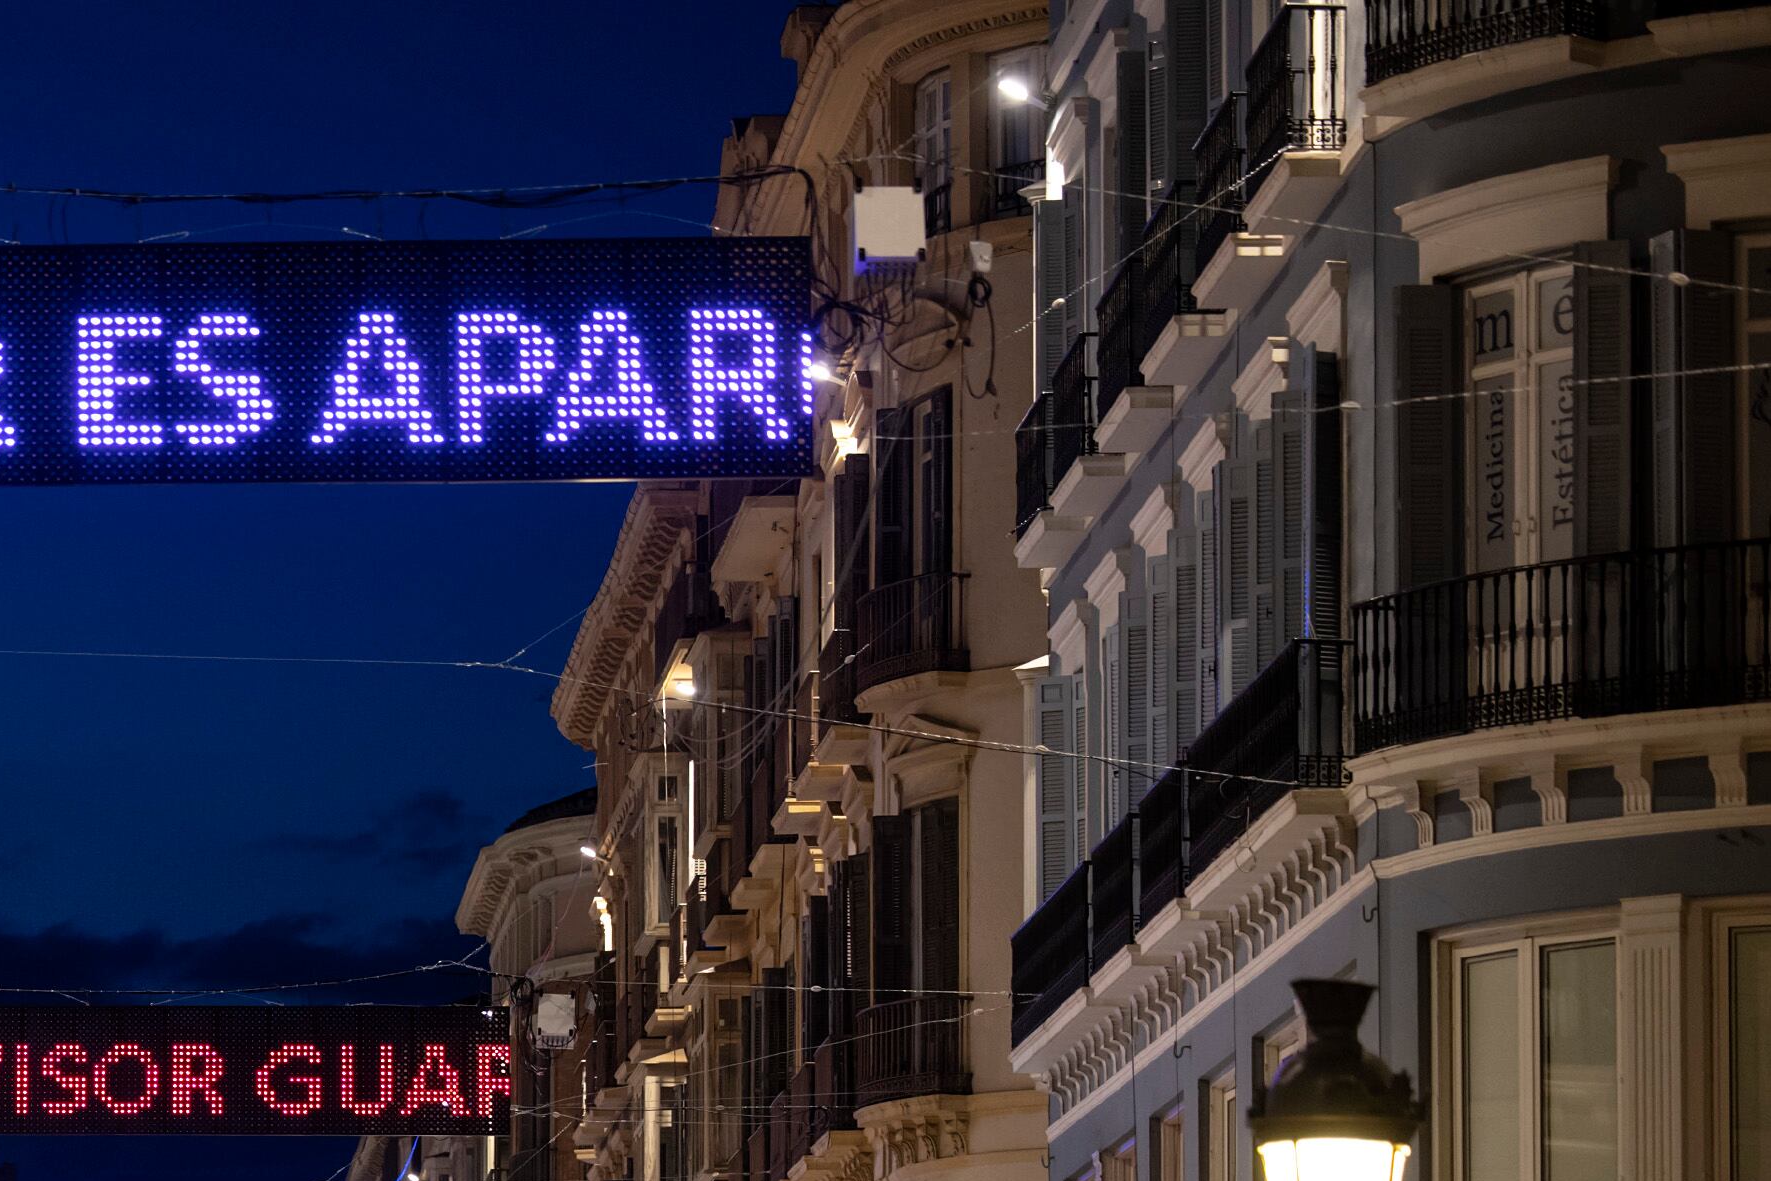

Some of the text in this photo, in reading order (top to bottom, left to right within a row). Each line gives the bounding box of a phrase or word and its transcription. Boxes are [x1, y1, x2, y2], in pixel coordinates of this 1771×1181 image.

[74, 312, 276, 448] ES
[308, 307, 813, 445] APAR
[254, 1042, 510, 1117] GUAR
